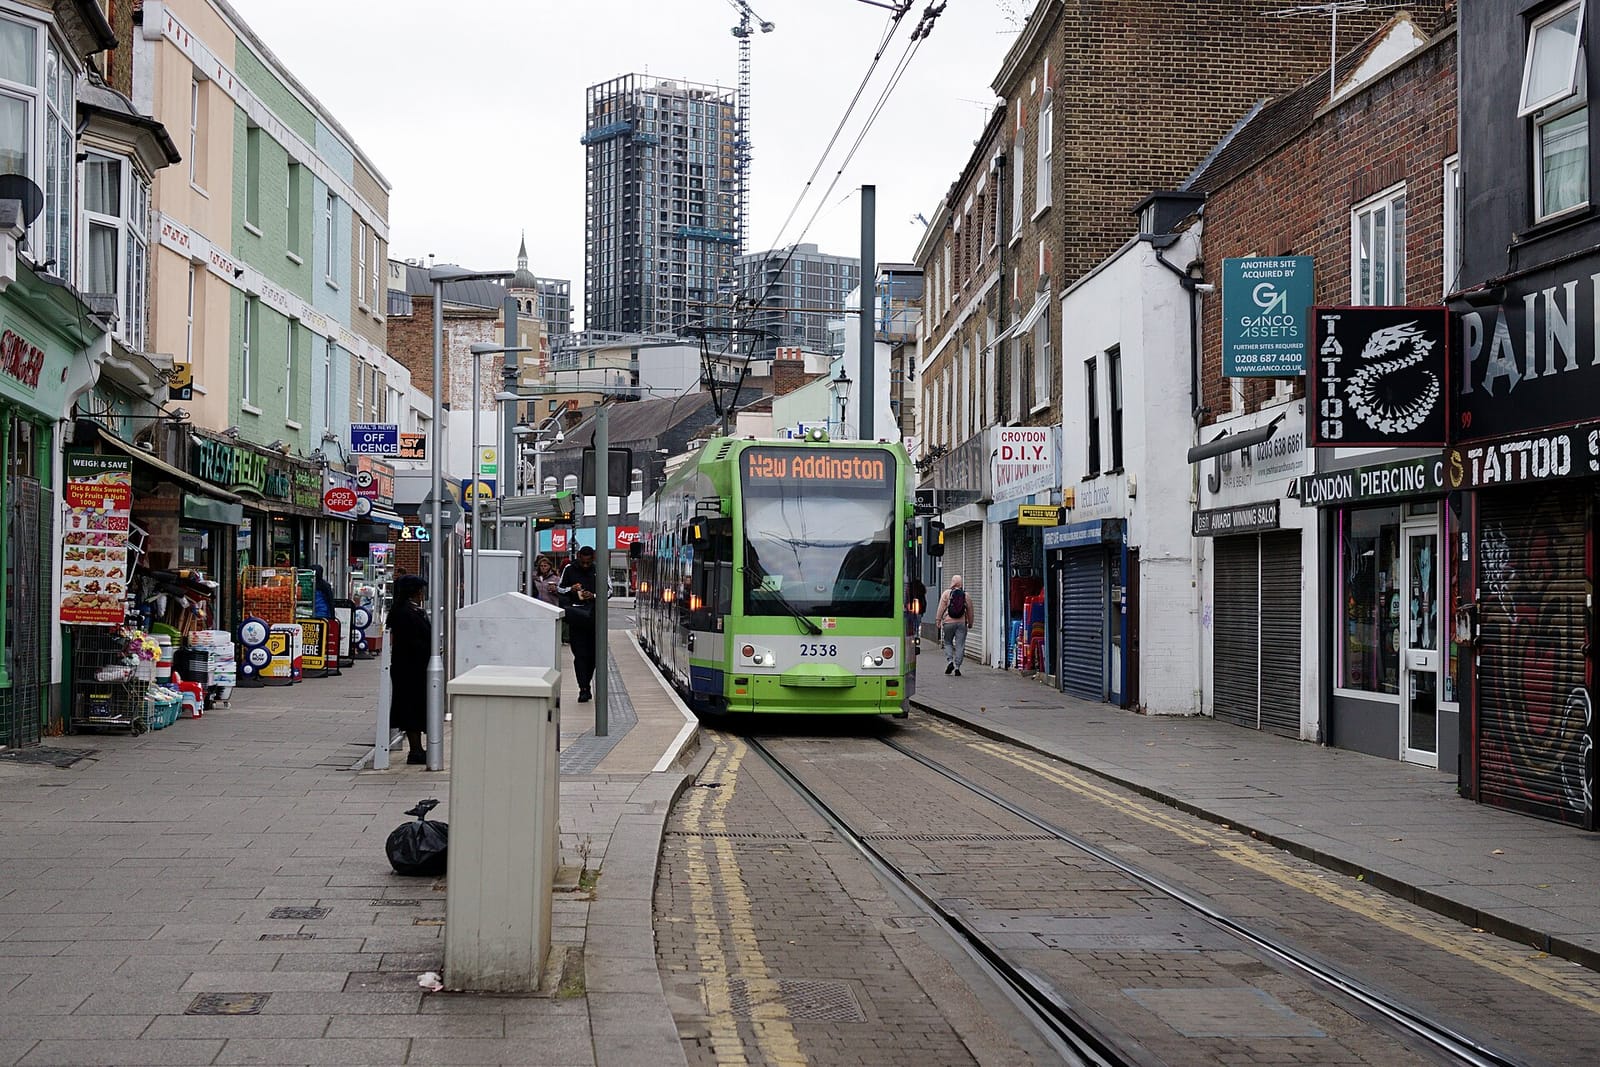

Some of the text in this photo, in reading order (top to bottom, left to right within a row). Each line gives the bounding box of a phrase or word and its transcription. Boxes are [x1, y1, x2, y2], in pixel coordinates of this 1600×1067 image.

[1241, 260, 1297, 269] ANOTHER SITE
[1242, 270, 1283, 279] ACQUIRED
[1241, 315, 1294, 327] GANCO
[1240, 326, 1298, 338] ASSETS
[1235, 353, 1302, 363] 0208 687 4400
[1320, 315, 1343, 439] TATTOO
[1461, 411, 1472, 429] 99
[363, 433, 385, 443] OFF
[400, 439, 419, 447] ASY
[1001, 432, 1046, 442] CROYDON
[351, 443, 397, 453] LICENCE
[1256, 440, 1273, 461] 0203
[1274, 437, 1287, 457] 638
[1287, 432, 1303, 455] 6861
[1001, 446, 1048, 460] D.I.Y.
[73, 459, 99, 468] WEIGH
[1467, 434, 1571, 487] TATTOO
[791, 456, 884, 480] Addington
[1305, 474, 1352, 503] LONDON
[1360, 464, 1425, 496] PIERCING
[327, 498, 353, 506] OFFICE
[1211, 512, 1232, 530] AWARD
[1233, 508, 1257, 527] WINNING
[800, 644, 838, 656] 2538
